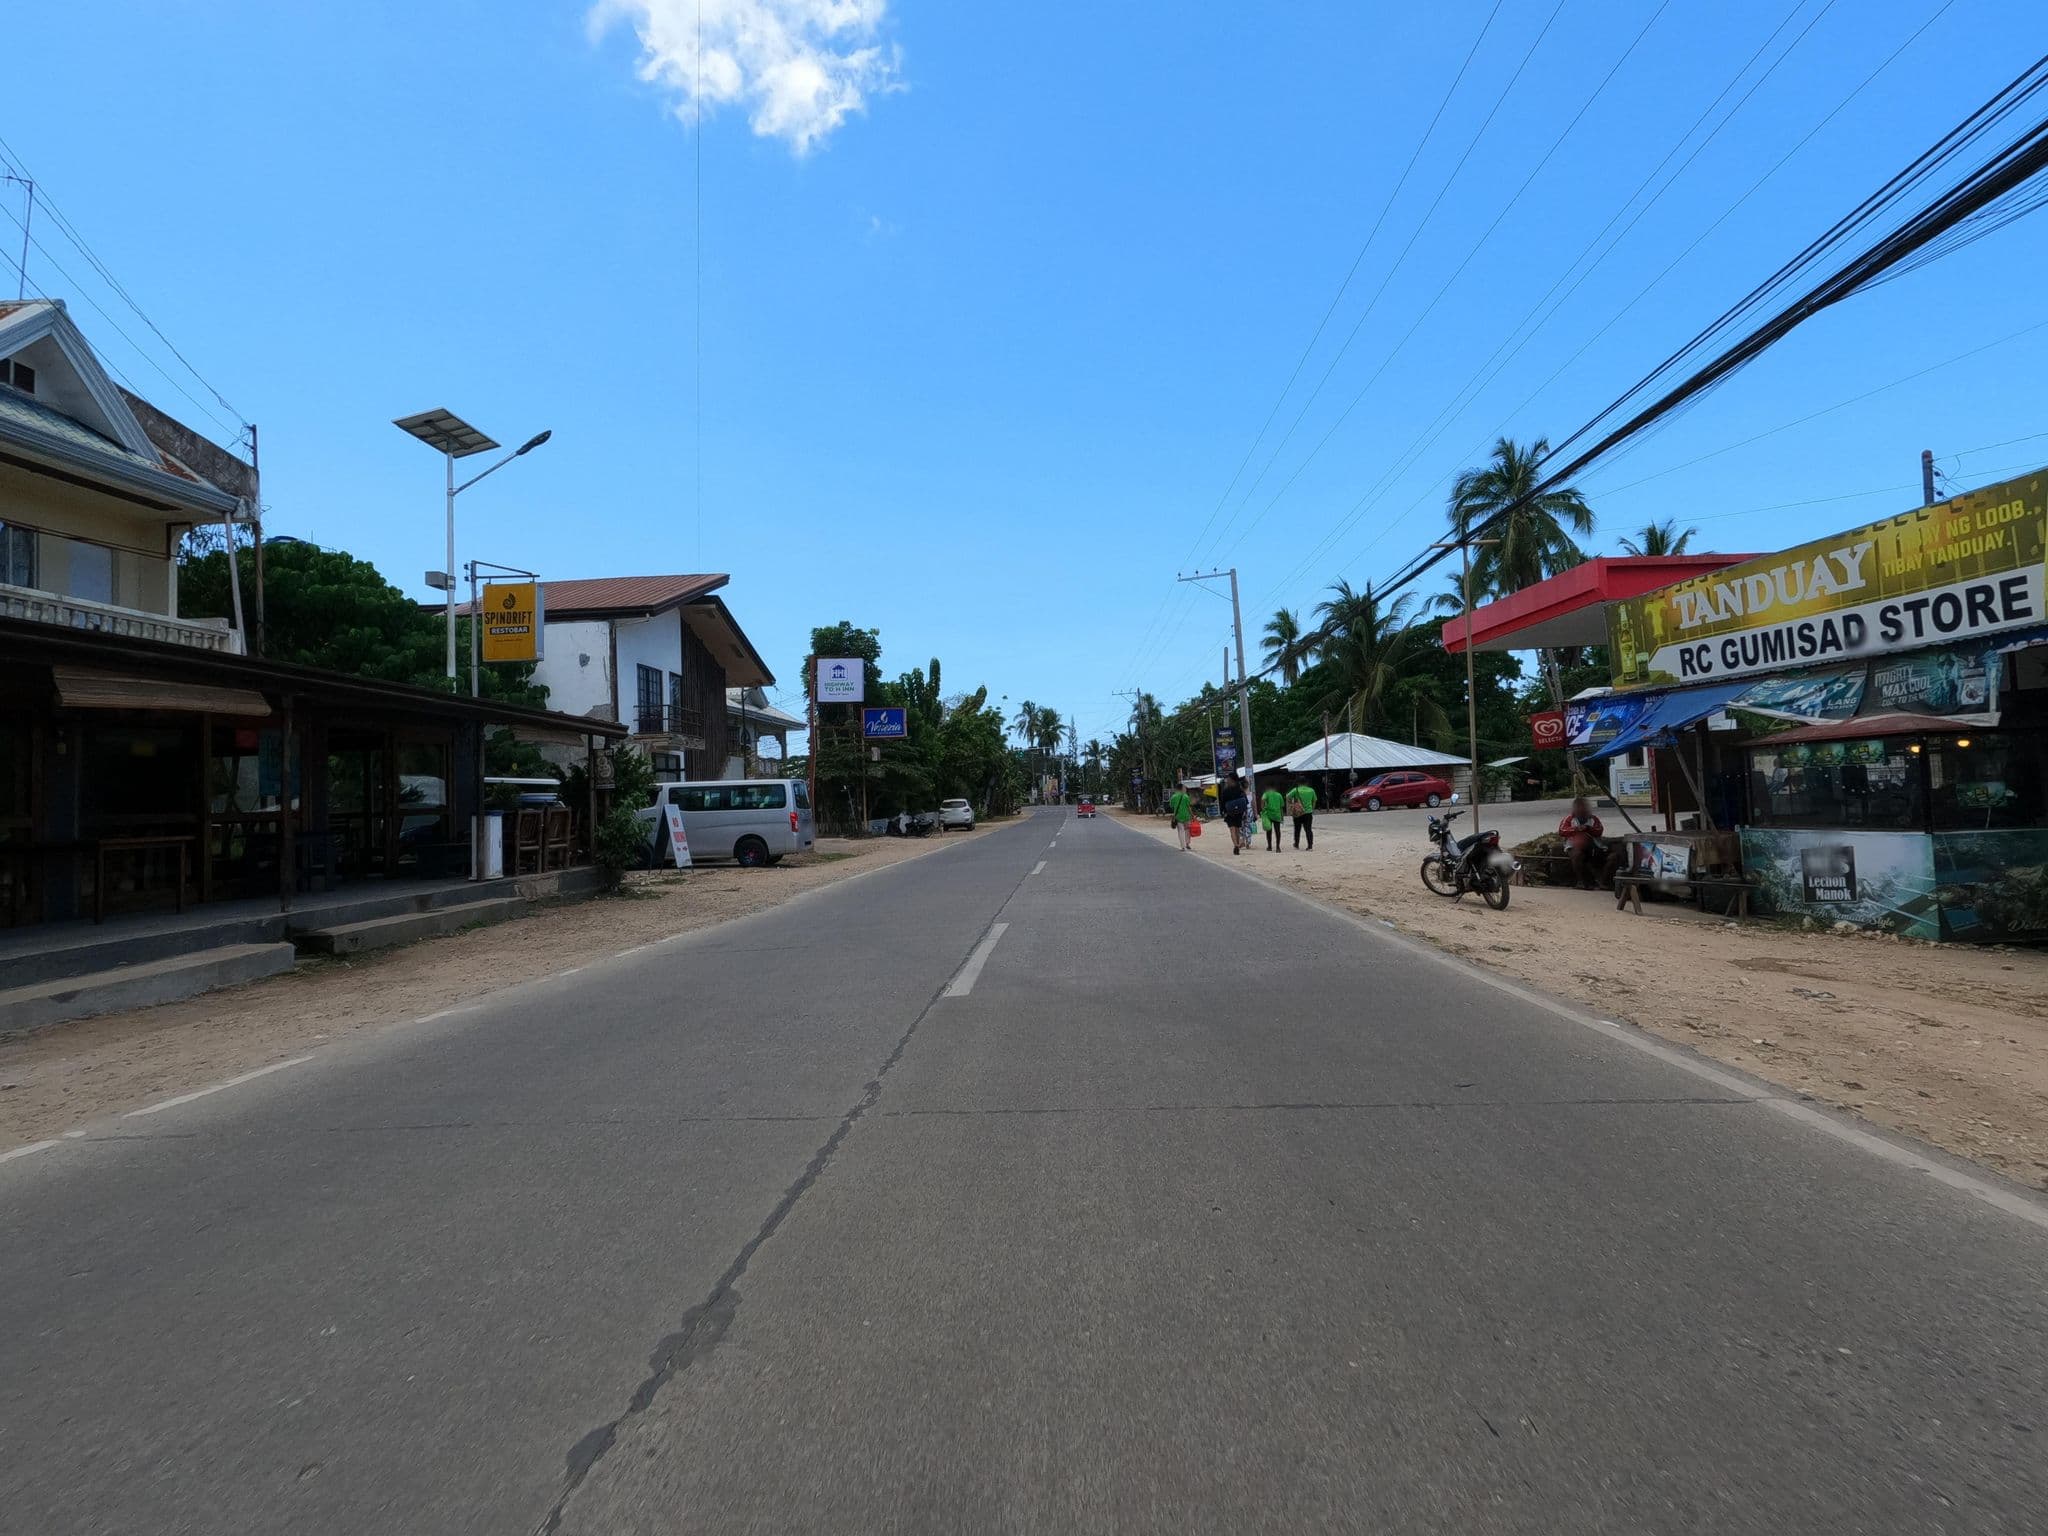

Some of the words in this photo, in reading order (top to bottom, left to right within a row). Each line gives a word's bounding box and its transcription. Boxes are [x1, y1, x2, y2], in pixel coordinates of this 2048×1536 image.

[1945, 515, 1971, 539] NG
[1882, 553, 1924, 578] TIBAY
[1672, 541, 1874, 630] TANDUAY
[484, 611, 533, 625] SPINDRIFT
[1679, 643, 1713, 677] RC
[1720, 613, 1867, 670] GUMISAD
[1879, 575, 2033, 643] STORE
[491, 626, 528, 634] RESTOBAR
[1874, 664, 1914, 688] MIGHTY
[1882, 682, 1908, 698] MAX
[1908, 675, 1933, 693] COOL
[1827, 697, 1857, 706] LANG
[1538, 736, 1563, 744] SELECTA
[1809, 876, 1847, 888] Lechon
[1815, 888, 1851, 901] Manok
